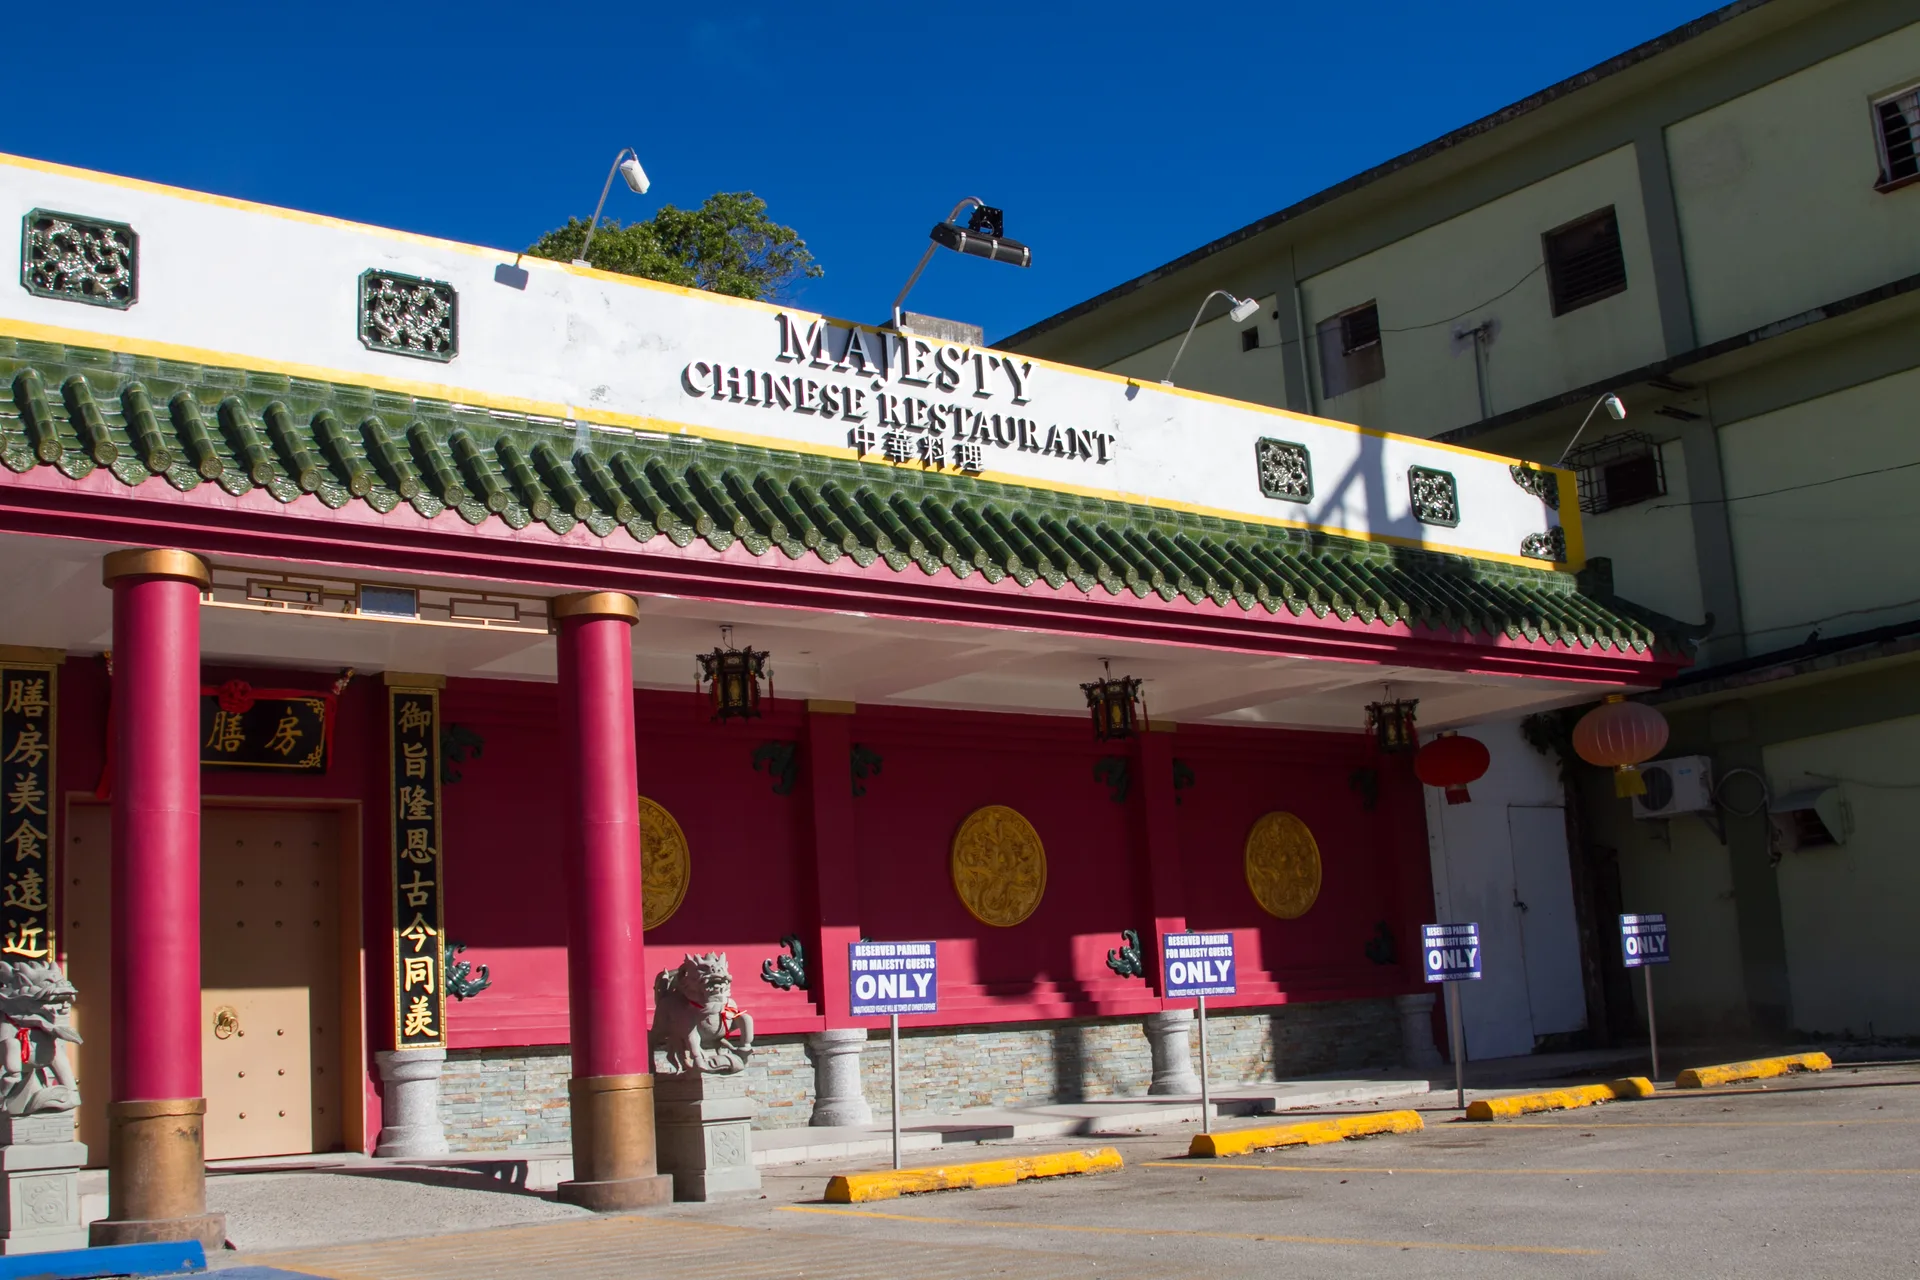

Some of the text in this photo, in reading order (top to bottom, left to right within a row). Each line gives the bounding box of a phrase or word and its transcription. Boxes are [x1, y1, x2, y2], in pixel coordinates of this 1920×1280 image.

[776, 311, 1039, 405] MAJESTY
[681, 360, 1116, 465] CHINESE RESTAURANT
[848, 423, 985, 475] 中華料理
[855, 944, 930, 956] RESERVED PARKING
[1168, 934, 1229, 946] RESERVED PARKING
[1425, 938, 1436, 948] FOR
[1436, 937, 1459, 947] MAJESTY
[1626, 935, 1666, 955] ONLY
[1166, 946, 1233, 959] FOR MAJESTY GUESTS
[1428, 947, 1478, 970] ONLY
[852, 957, 936, 971] FOR MAJESTY GUESTS
[1169, 960, 1231, 985] ONLY
[855, 973, 933, 1000] ONLY
